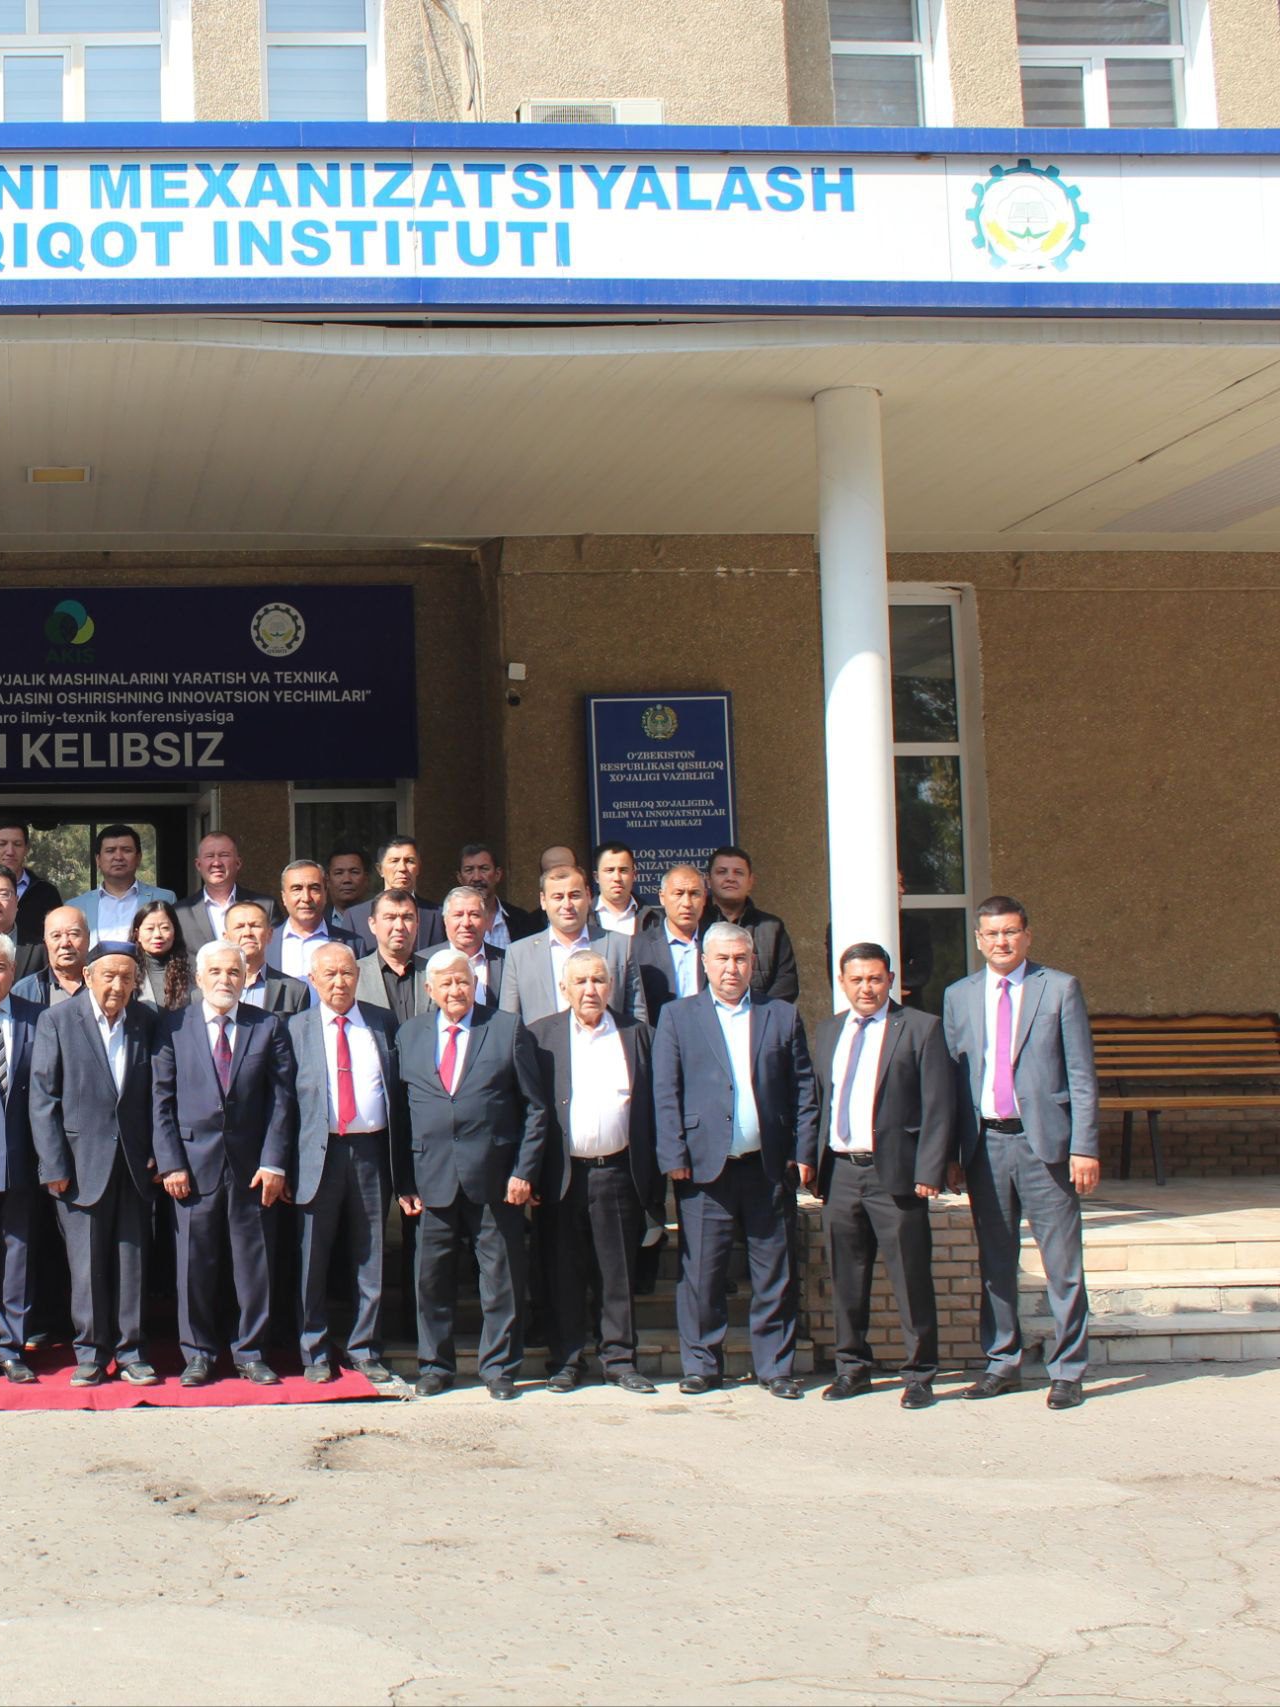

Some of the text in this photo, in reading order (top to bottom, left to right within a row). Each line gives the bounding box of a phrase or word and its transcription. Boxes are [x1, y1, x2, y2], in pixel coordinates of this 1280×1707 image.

[91, 162, 856, 212] MEXANIZATSIYALASH
[214, 220, 570, 267] INSTITUTI
[49, 672, 169, 685] MASHINALARINI
[172, 671, 246, 684] YARATISH
[250, 671, 270, 683] VA
[274, 671, 339, 683] TEXNIKA
[57, 691, 164, 704] OSHIRISHNING
[168, 690, 270, 703] INNOVATSION
[21, 711, 107, 726] ilmiy-texnik
[110, 710, 234, 726] konferensiyasiga
[22, 732, 225, 769] KELIBSIZ
[600, 760, 724, 771] RESPUBLIKASI QISHLOQ
[662, 772, 714, 781] VAZIRLIGI
[613, 801, 654, 810] QISHLOQ
[602, 809, 726, 819] BILIM VA INNOVATSIYALAR
[627, 819, 702, 828] MILLIY MARKAZI
